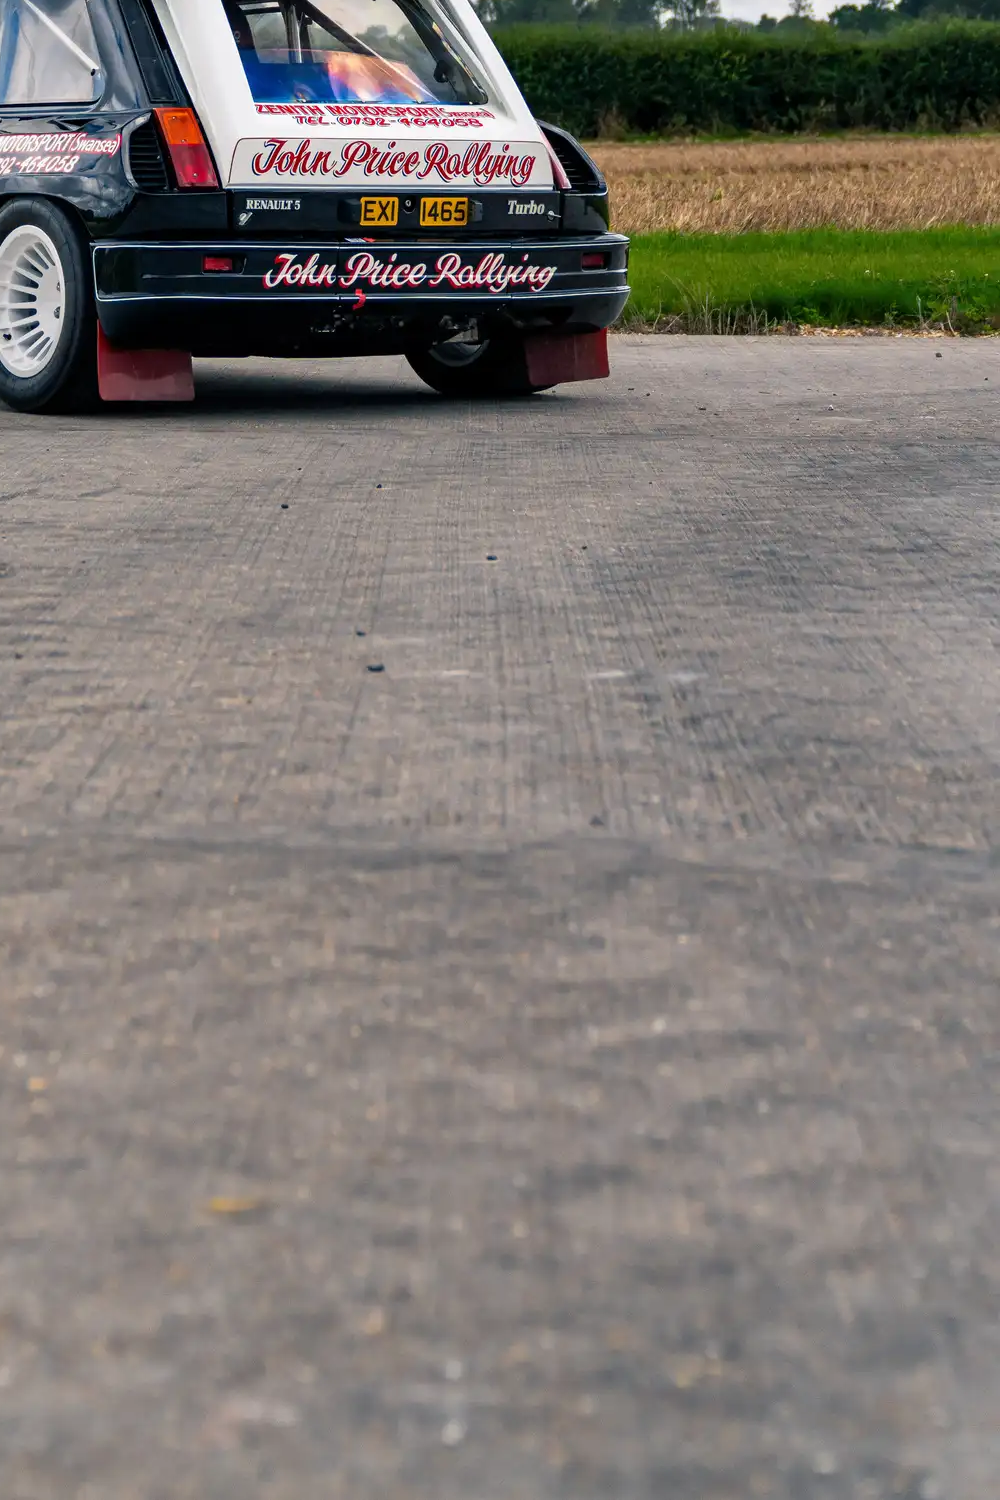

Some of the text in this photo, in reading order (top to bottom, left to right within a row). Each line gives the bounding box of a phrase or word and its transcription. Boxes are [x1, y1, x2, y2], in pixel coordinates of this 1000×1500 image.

[255, 104, 325, 116] ZENITH
[337, 116, 483, 128] 0792-464058
[252, 138, 536, 187] John Price Rallying
[246, 199, 301, 210] RENAULT 5
[422, 201, 466, 222] 1465
[507, 200, 545, 215] Turbo
[264, 252, 557, 293] John Price Rallying
